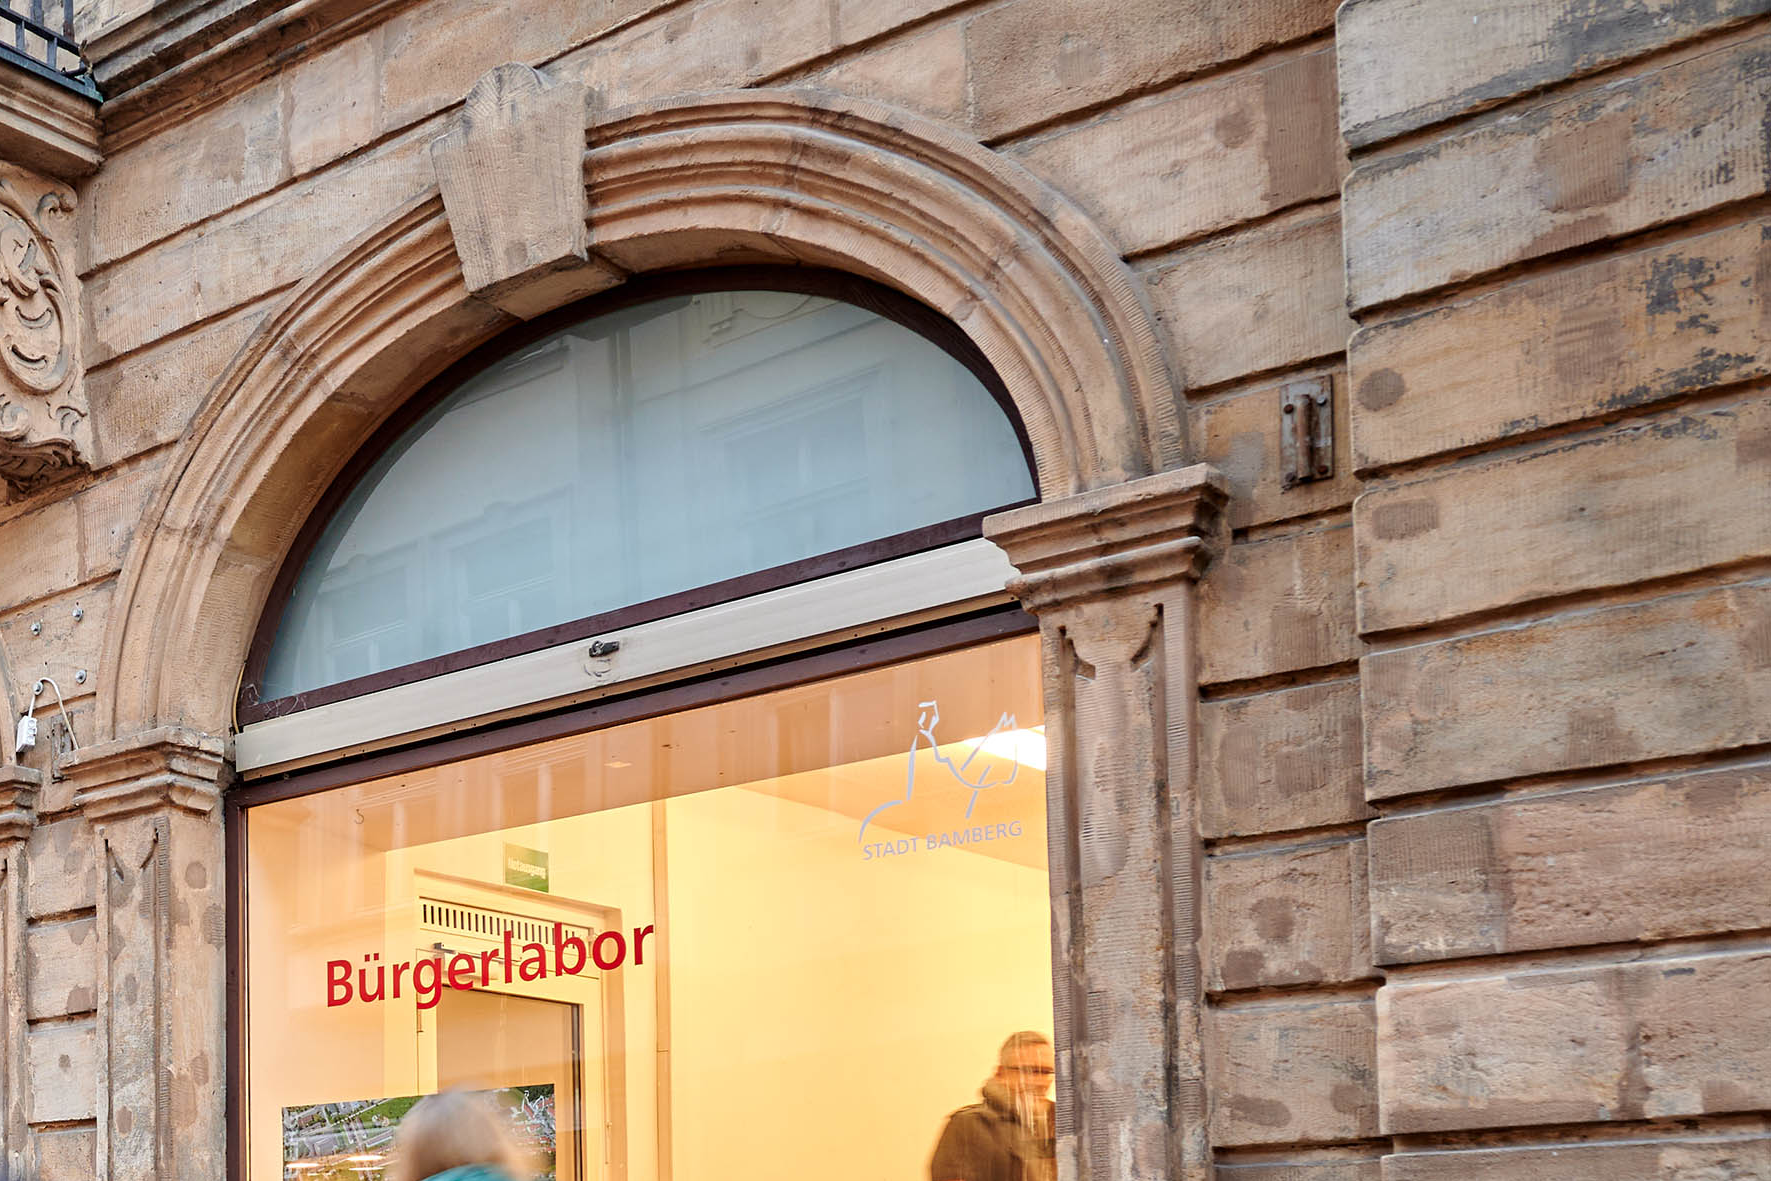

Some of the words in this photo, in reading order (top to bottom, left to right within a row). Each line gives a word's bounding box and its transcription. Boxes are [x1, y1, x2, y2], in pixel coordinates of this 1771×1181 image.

[863, 839, 918, 861] STADT
[926, 820, 1022, 850] BAMBERG
[327, 922, 654, 1010] Bürgerlabor
